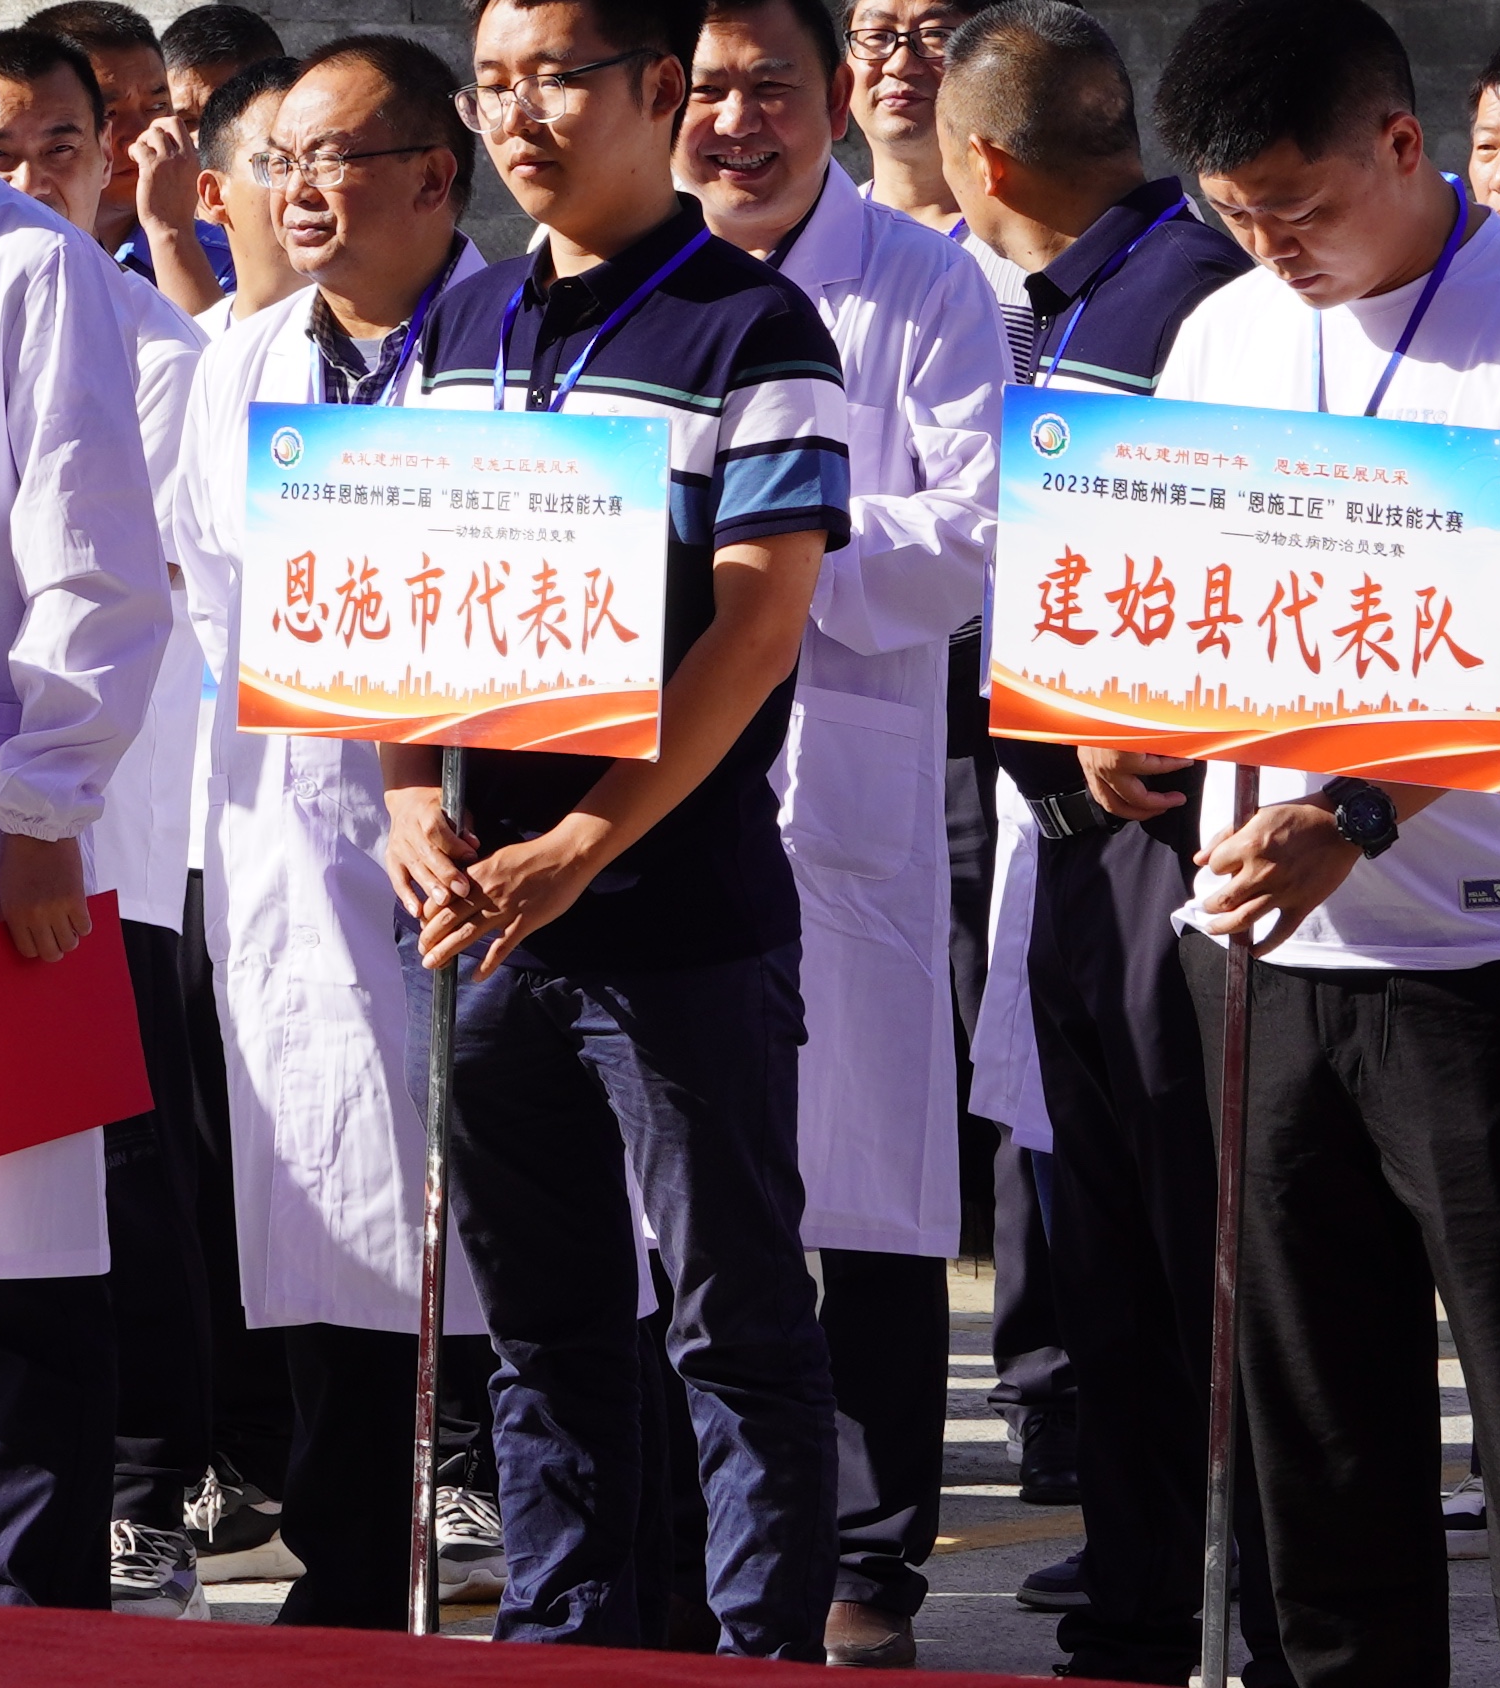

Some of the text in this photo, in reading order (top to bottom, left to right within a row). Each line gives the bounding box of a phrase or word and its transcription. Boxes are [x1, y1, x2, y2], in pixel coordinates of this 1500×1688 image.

[1042, 471, 1464, 533] 2023年恩施州第二届“恩施工匠”职业技能大赛
[1115, 443, 1410, 486] 献礼建州四十年 恩施工匠展风采
[272, 551, 639, 659] 恩施市代表队
[1031, 545, 1483, 679] 建始县代表队
